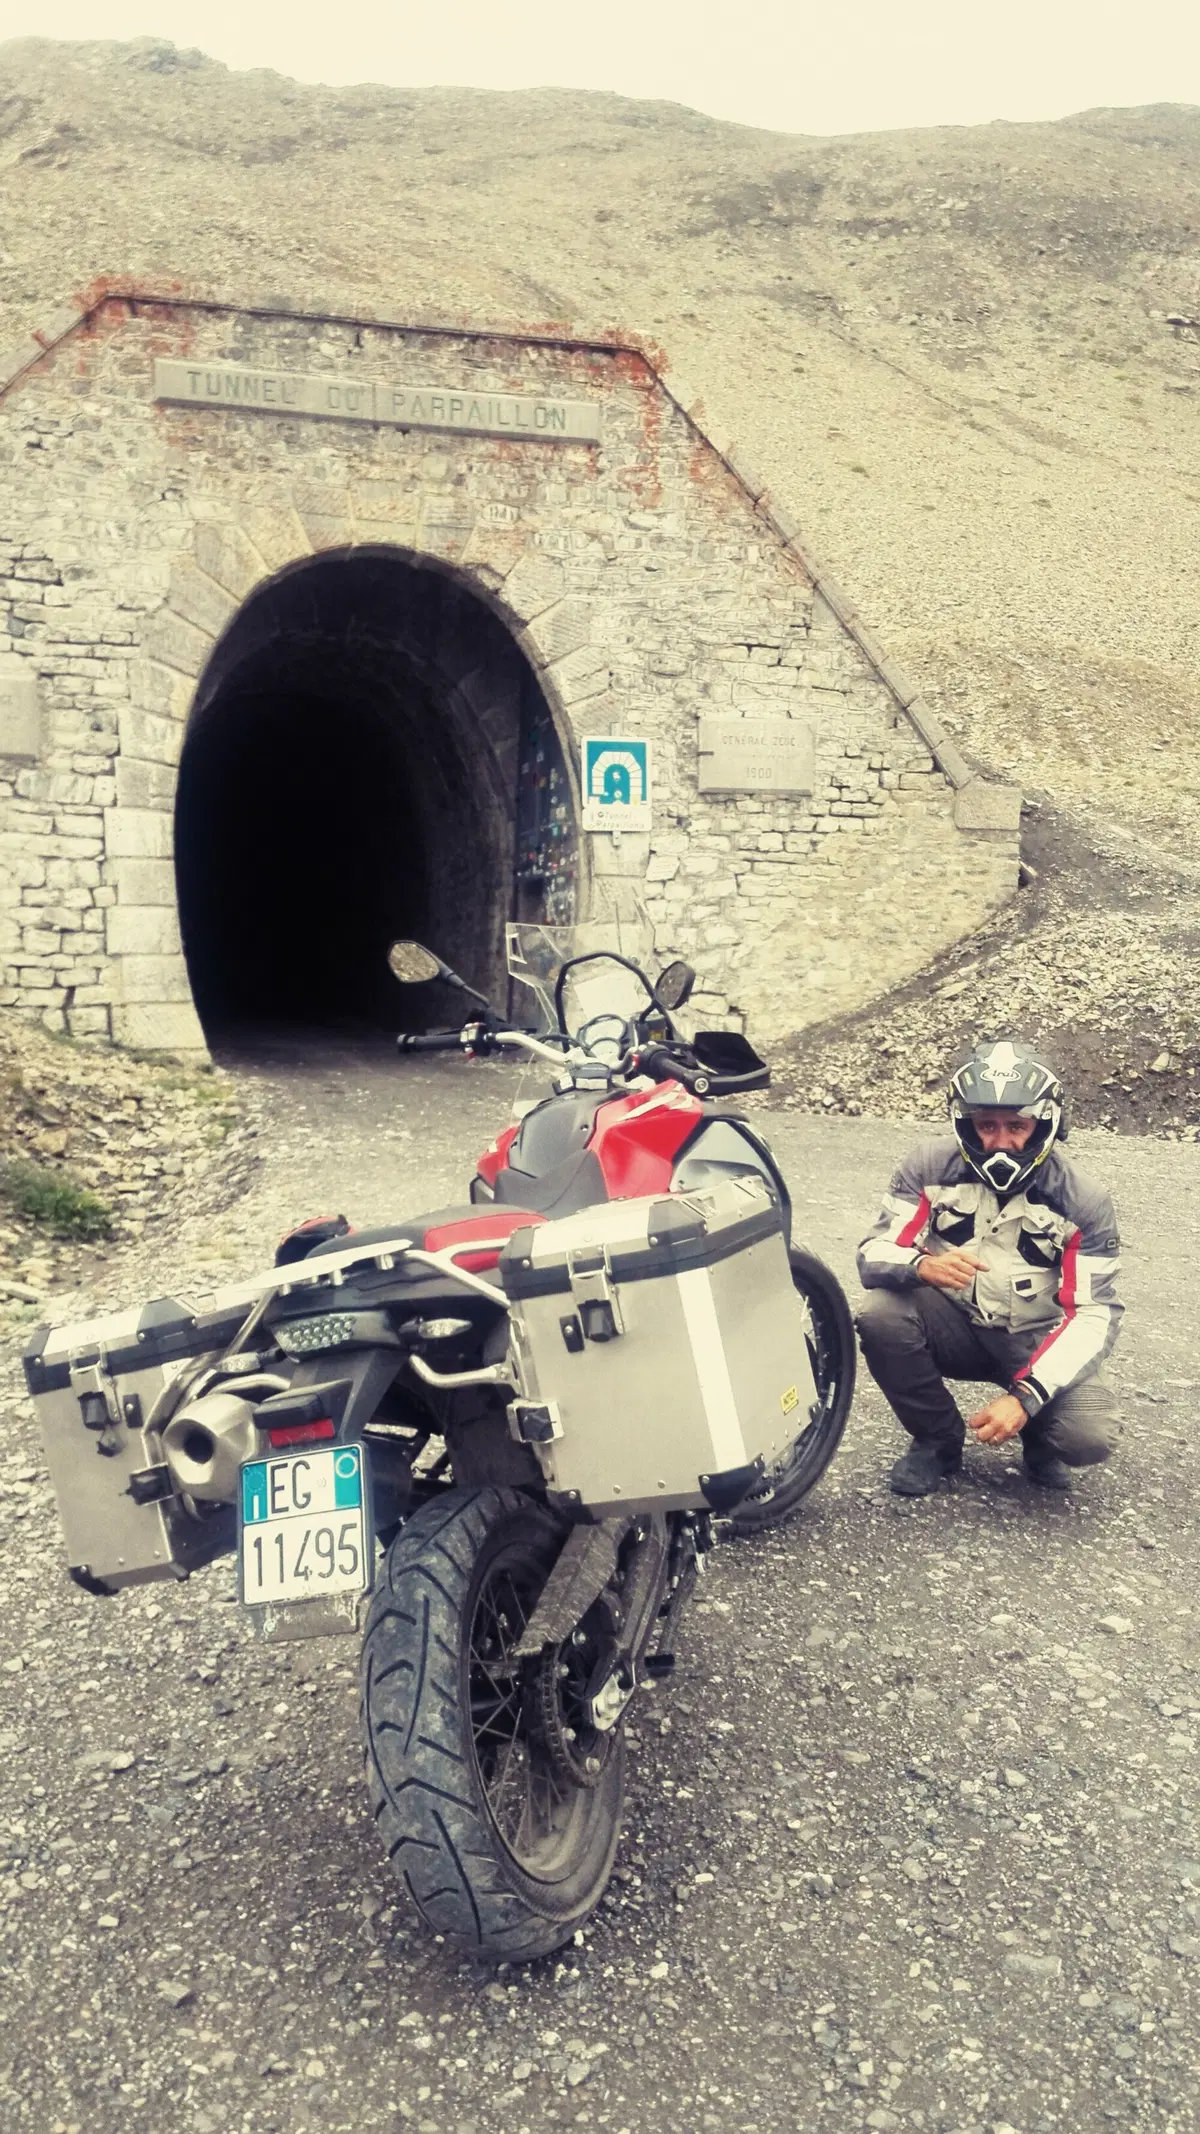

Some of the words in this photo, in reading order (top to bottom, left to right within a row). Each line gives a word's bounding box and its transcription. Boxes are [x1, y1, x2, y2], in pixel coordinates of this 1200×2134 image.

[187, 370, 297, 404] TUNNEL
[327, 386, 361, 411] DU
[391, 393, 568, 430] PARPAILLON
[270, 1460, 312, 1514] EG
[253, 1522, 359, 1587] 11495
